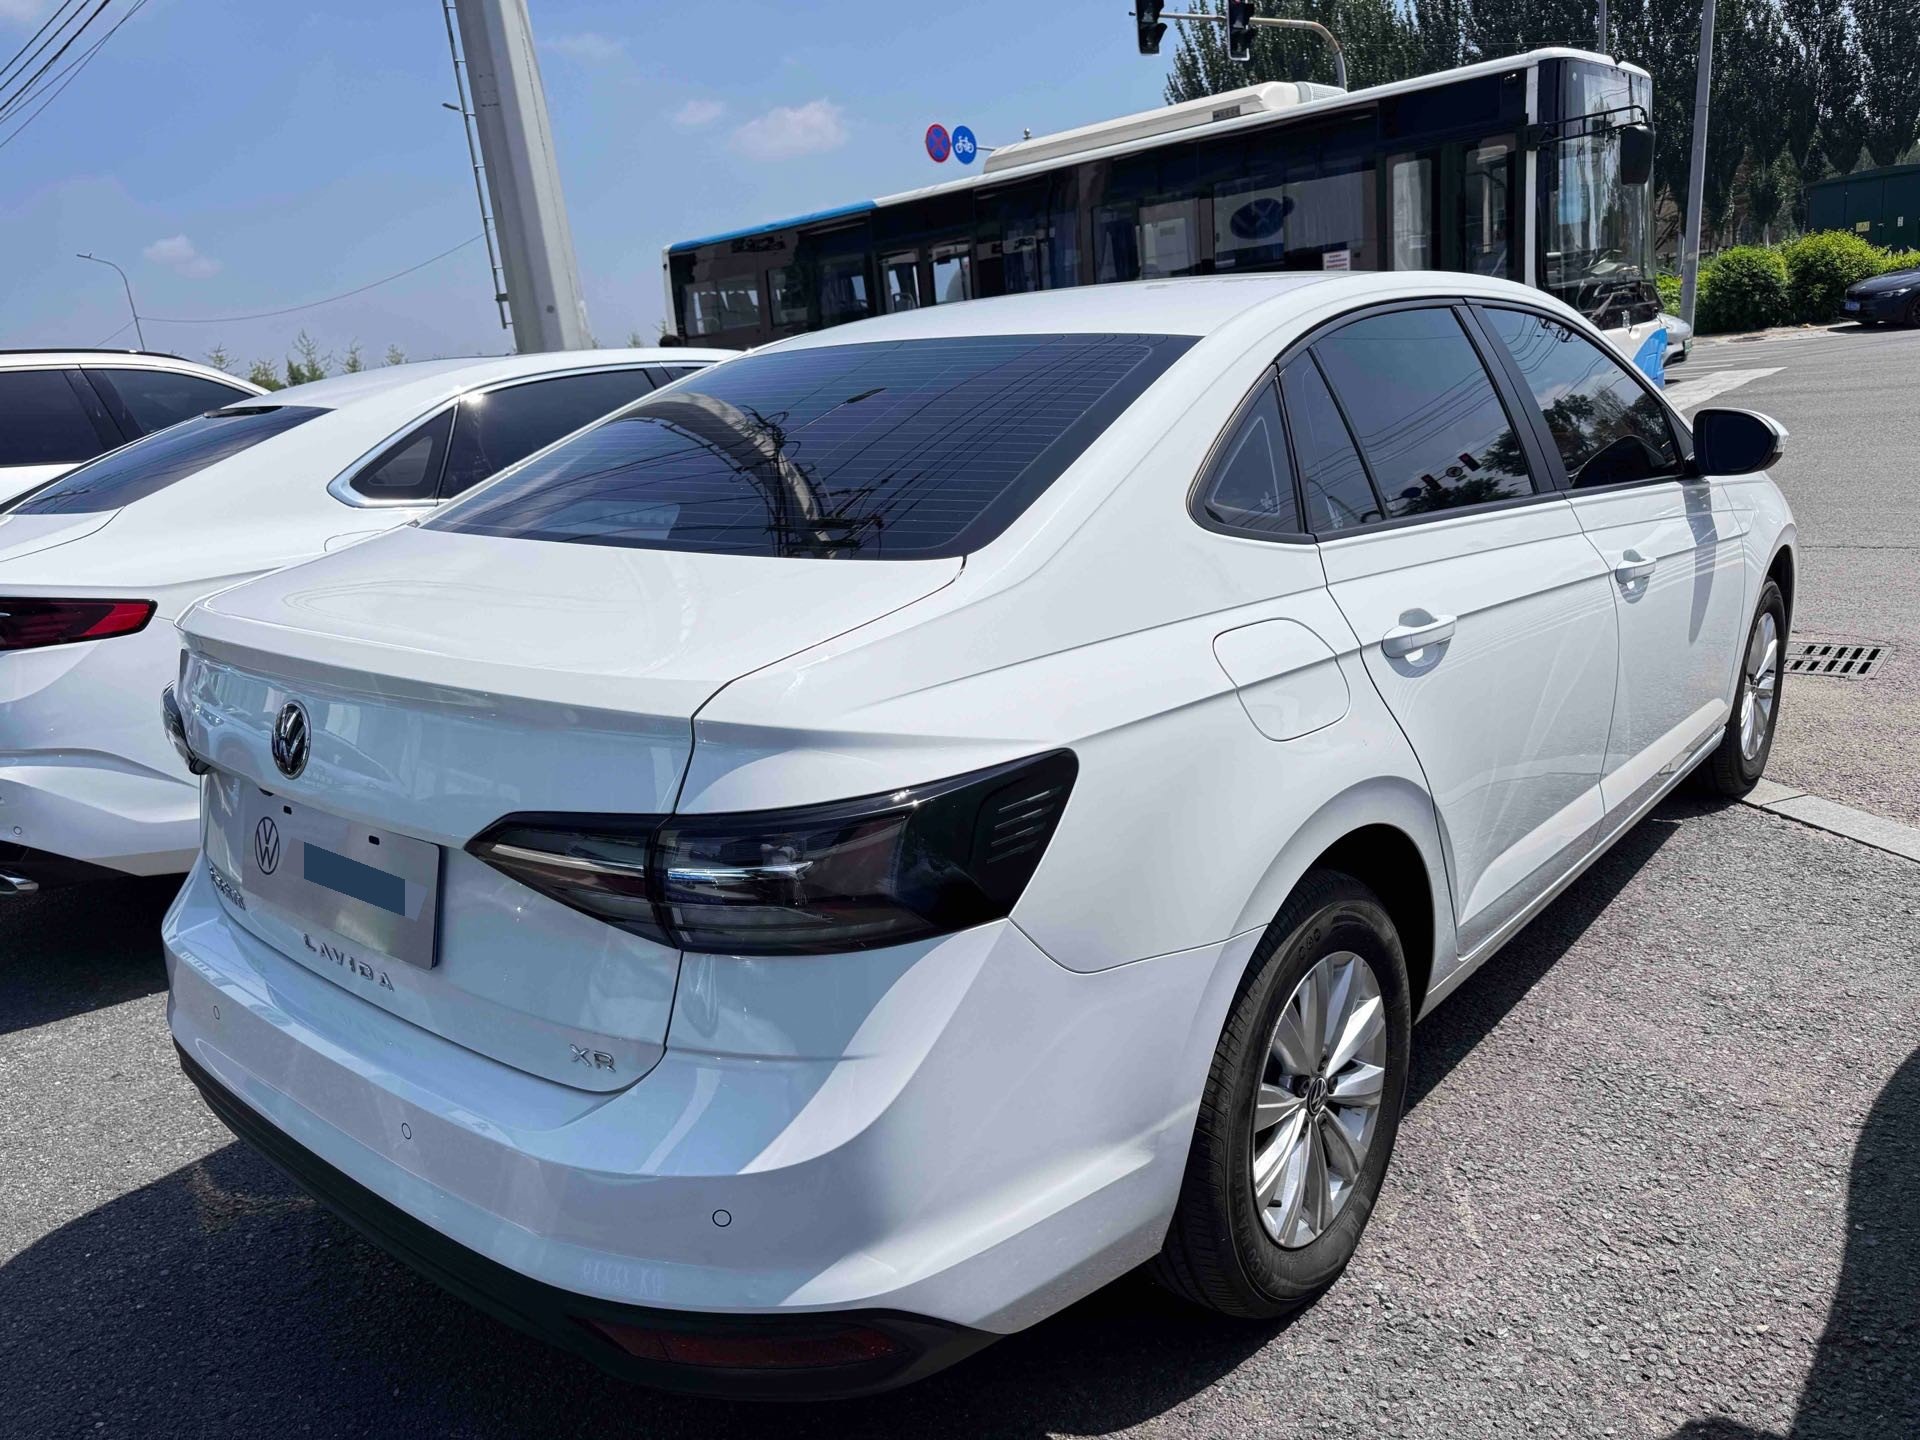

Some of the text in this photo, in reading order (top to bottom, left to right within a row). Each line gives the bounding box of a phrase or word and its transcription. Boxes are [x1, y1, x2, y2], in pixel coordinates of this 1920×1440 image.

[273, 701, 309, 777] VW
[256, 817, 280, 874] VW
[303, 933, 395, 992] LAVIDA
[569, 1043, 617, 1073] XR
